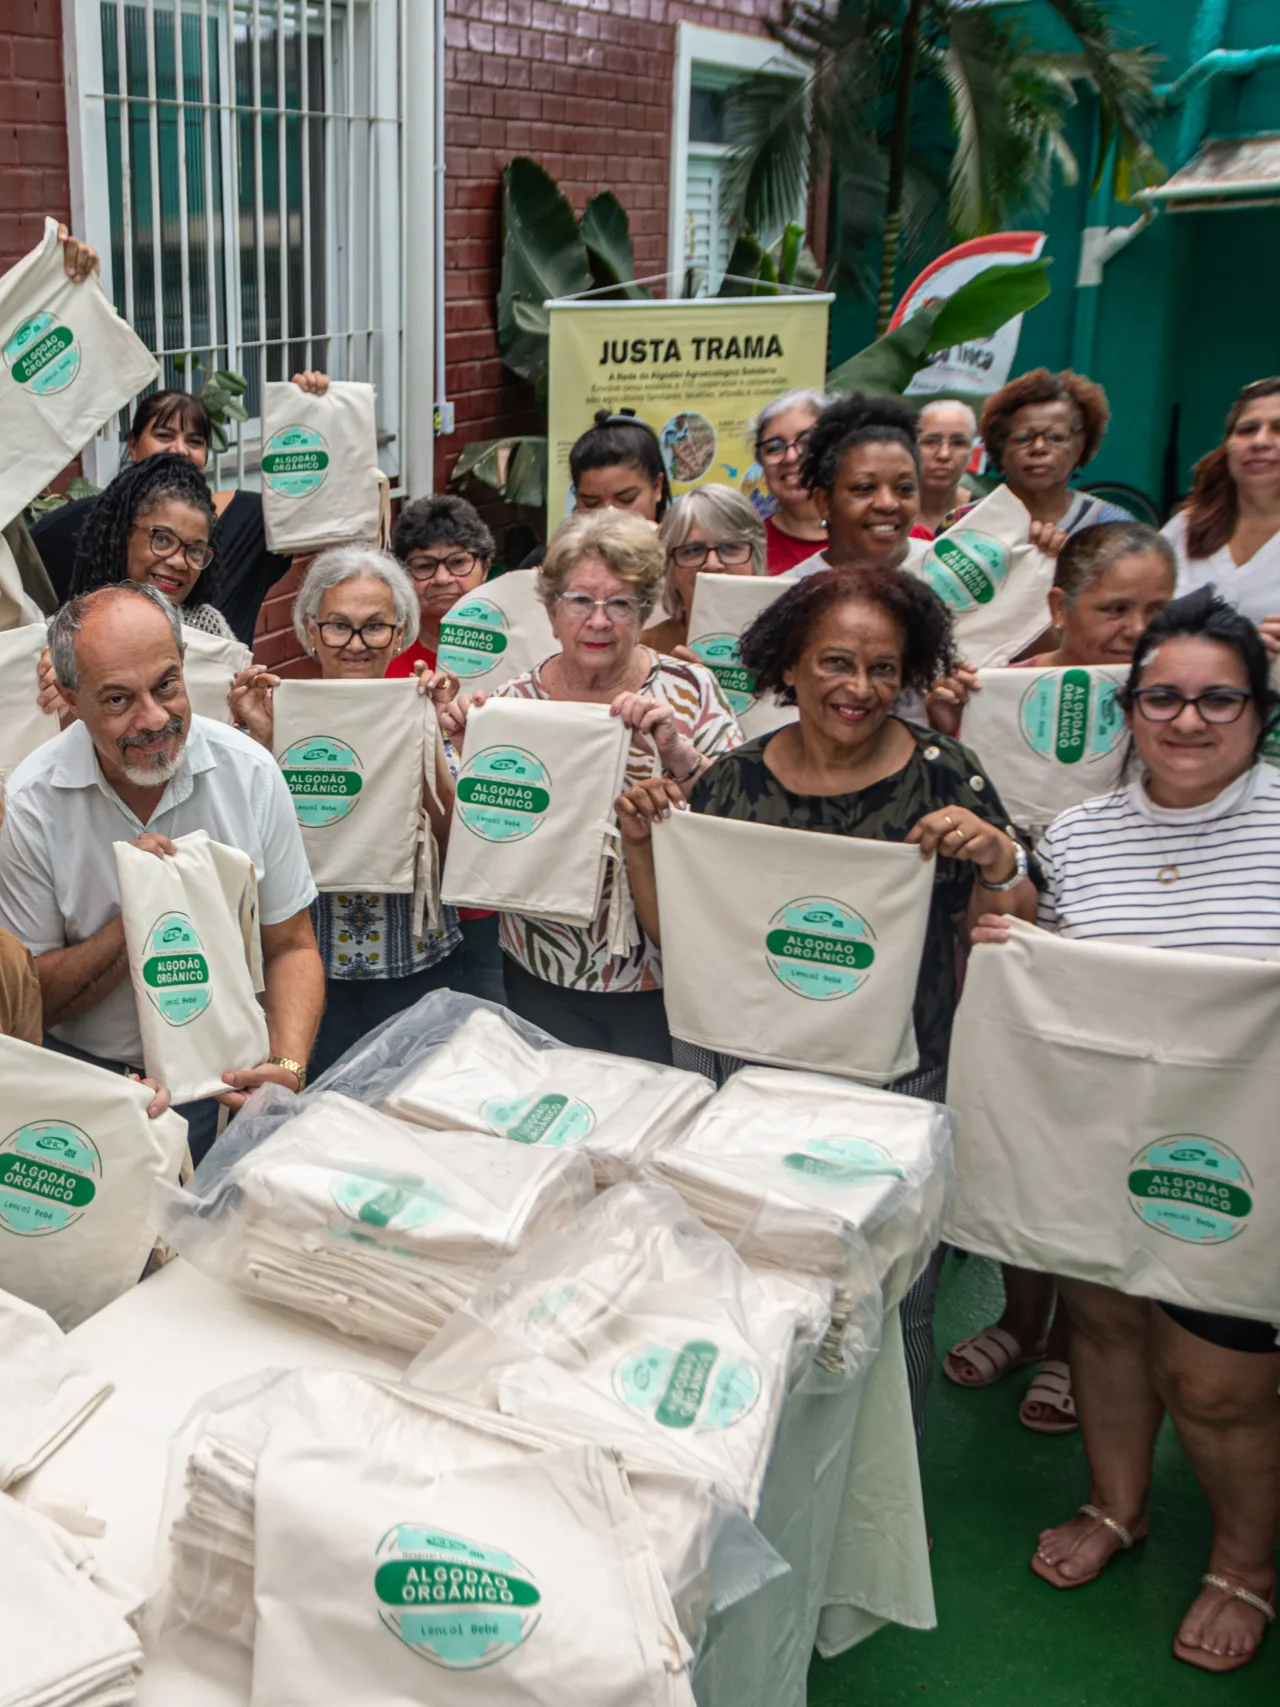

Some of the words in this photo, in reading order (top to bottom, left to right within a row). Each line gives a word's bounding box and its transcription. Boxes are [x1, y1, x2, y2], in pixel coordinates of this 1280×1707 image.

[22, 335, 58, 369] ALGODÃO
[25, 340, 65, 376] ORGÂNICO
[599, 338, 682, 365] JUSTA
[691, 334, 784, 360] TRAMA
[273, 461, 319, 472] ORGÂNICO
[275, 453, 317, 464] ALGODÃO
[941, 552, 981, 596] ORGÂNICO
[950, 549, 988, 589] ALGODÃO
[441, 635, 493, 650] ORGÂNICO
[444, 627, 493, 642] ALGODÃO
[714, 669, 747, 681] ODÃO
[720, 678, 748, 690] NICO
[1059, 683, 1074, 748] ORGÂNICO
[1070, 686, 1085, 746] ALGODÃO
[287, 783, 347, 793] ORGÂNICO
[289, 773, 346, 784] ALGODÃO
[470, 792, 534, 810] ORGÂNICO
[474, 783, 533, 800] ALGODÃO
[783, 945, 856, 965] ORGÂNICO
[787, 935, 854, 955] ALGODÃO
[157, 957, 201, 972] ALGODÃO
[156, 969, 203, 984] ORGÂNICO
[11, 1161, 76, 1189] ALGODÃO
[4, 1172, 73, 1201] ORGÂNICO
[1151, 1175, 1230, 1199] ALGODÃO
[1147, 1185, 1231, 1211] ORGÂNICO
[406, 1565, 508, 1589] ALGODÃO
[401, 1581, 513, 1604] ORGÂNICO
